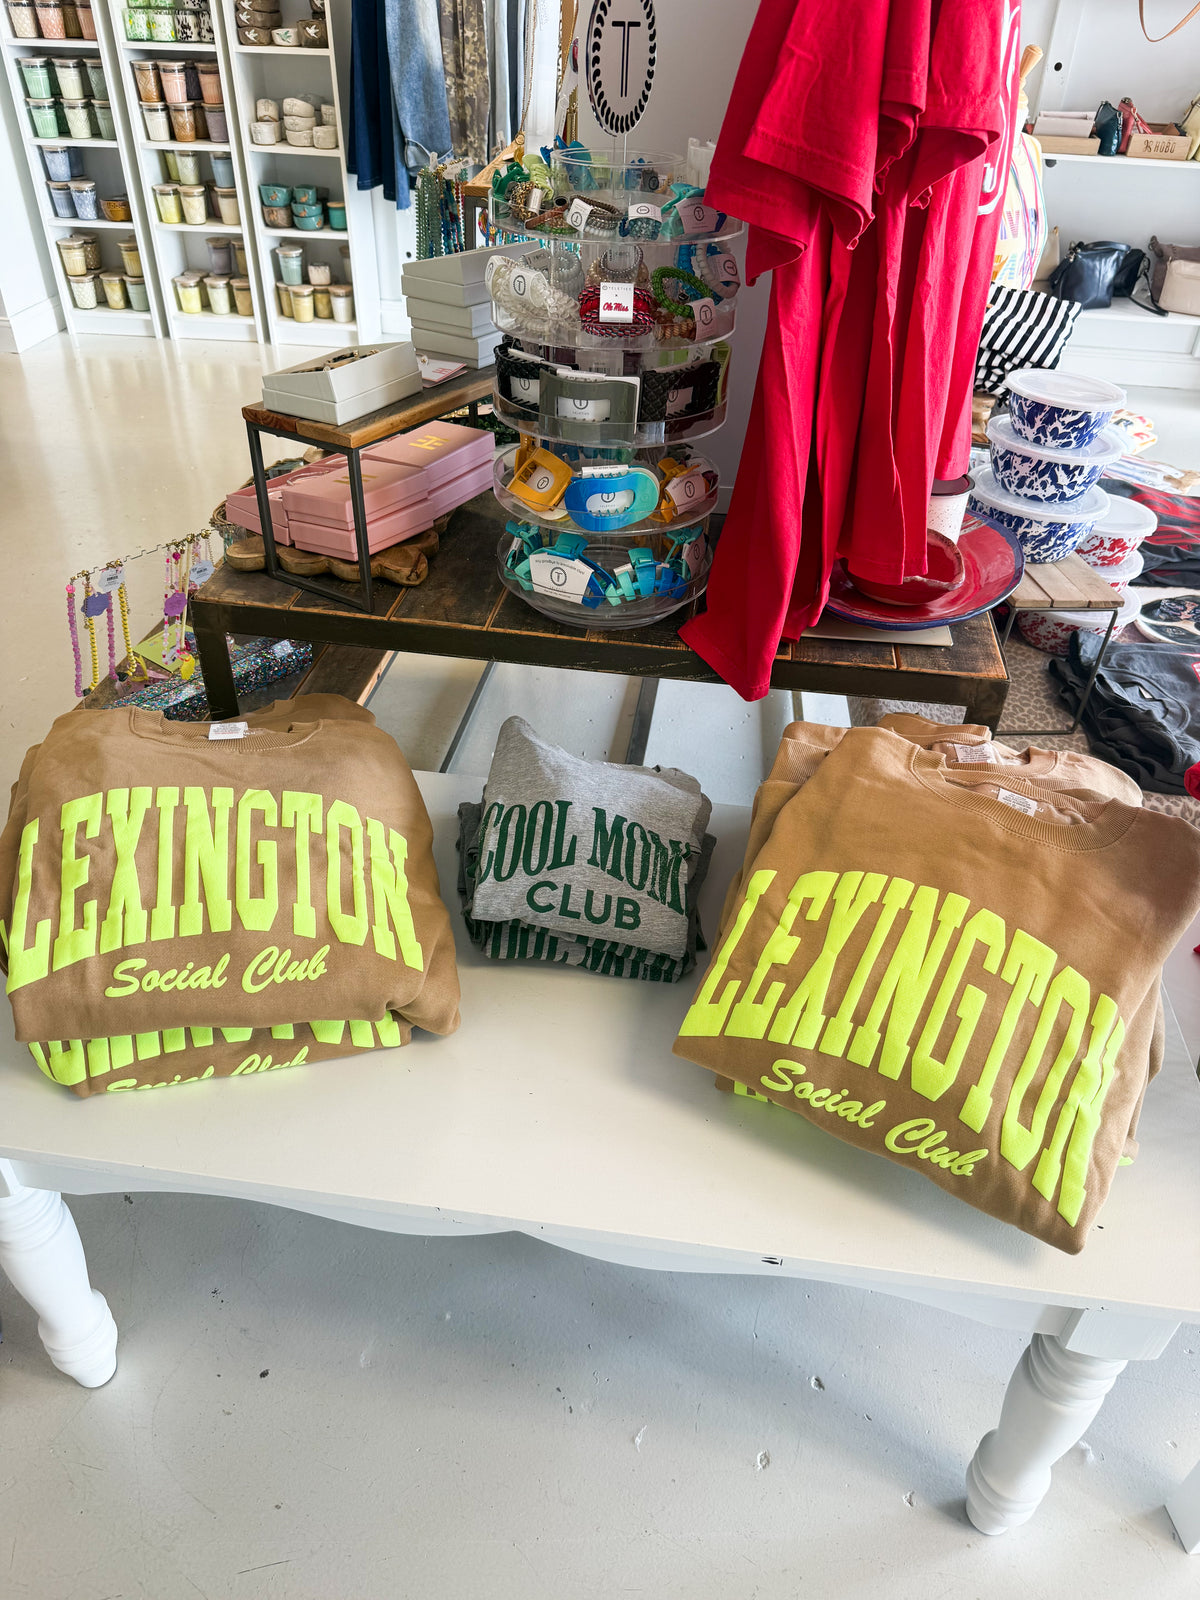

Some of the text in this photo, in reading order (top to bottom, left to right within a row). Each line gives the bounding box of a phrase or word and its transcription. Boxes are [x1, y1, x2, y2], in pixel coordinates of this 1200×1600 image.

[612, 21, 641, 97] T
[1154, 141, 1176, 153] HOBO
[603, 302, 629, 312] Ole Miss
[478, 800, 577, 884] COOL
[6, 786, 423, 995] LEXINGTON
[526, 880, 641, 931] CLUB
[105, 945, 330, 998] Social Club
[678, 870, 1125, 1227] LEXINGTON
[760, 1058, 885, 1128] Social
[885, 1118, 989, 1177] Club
